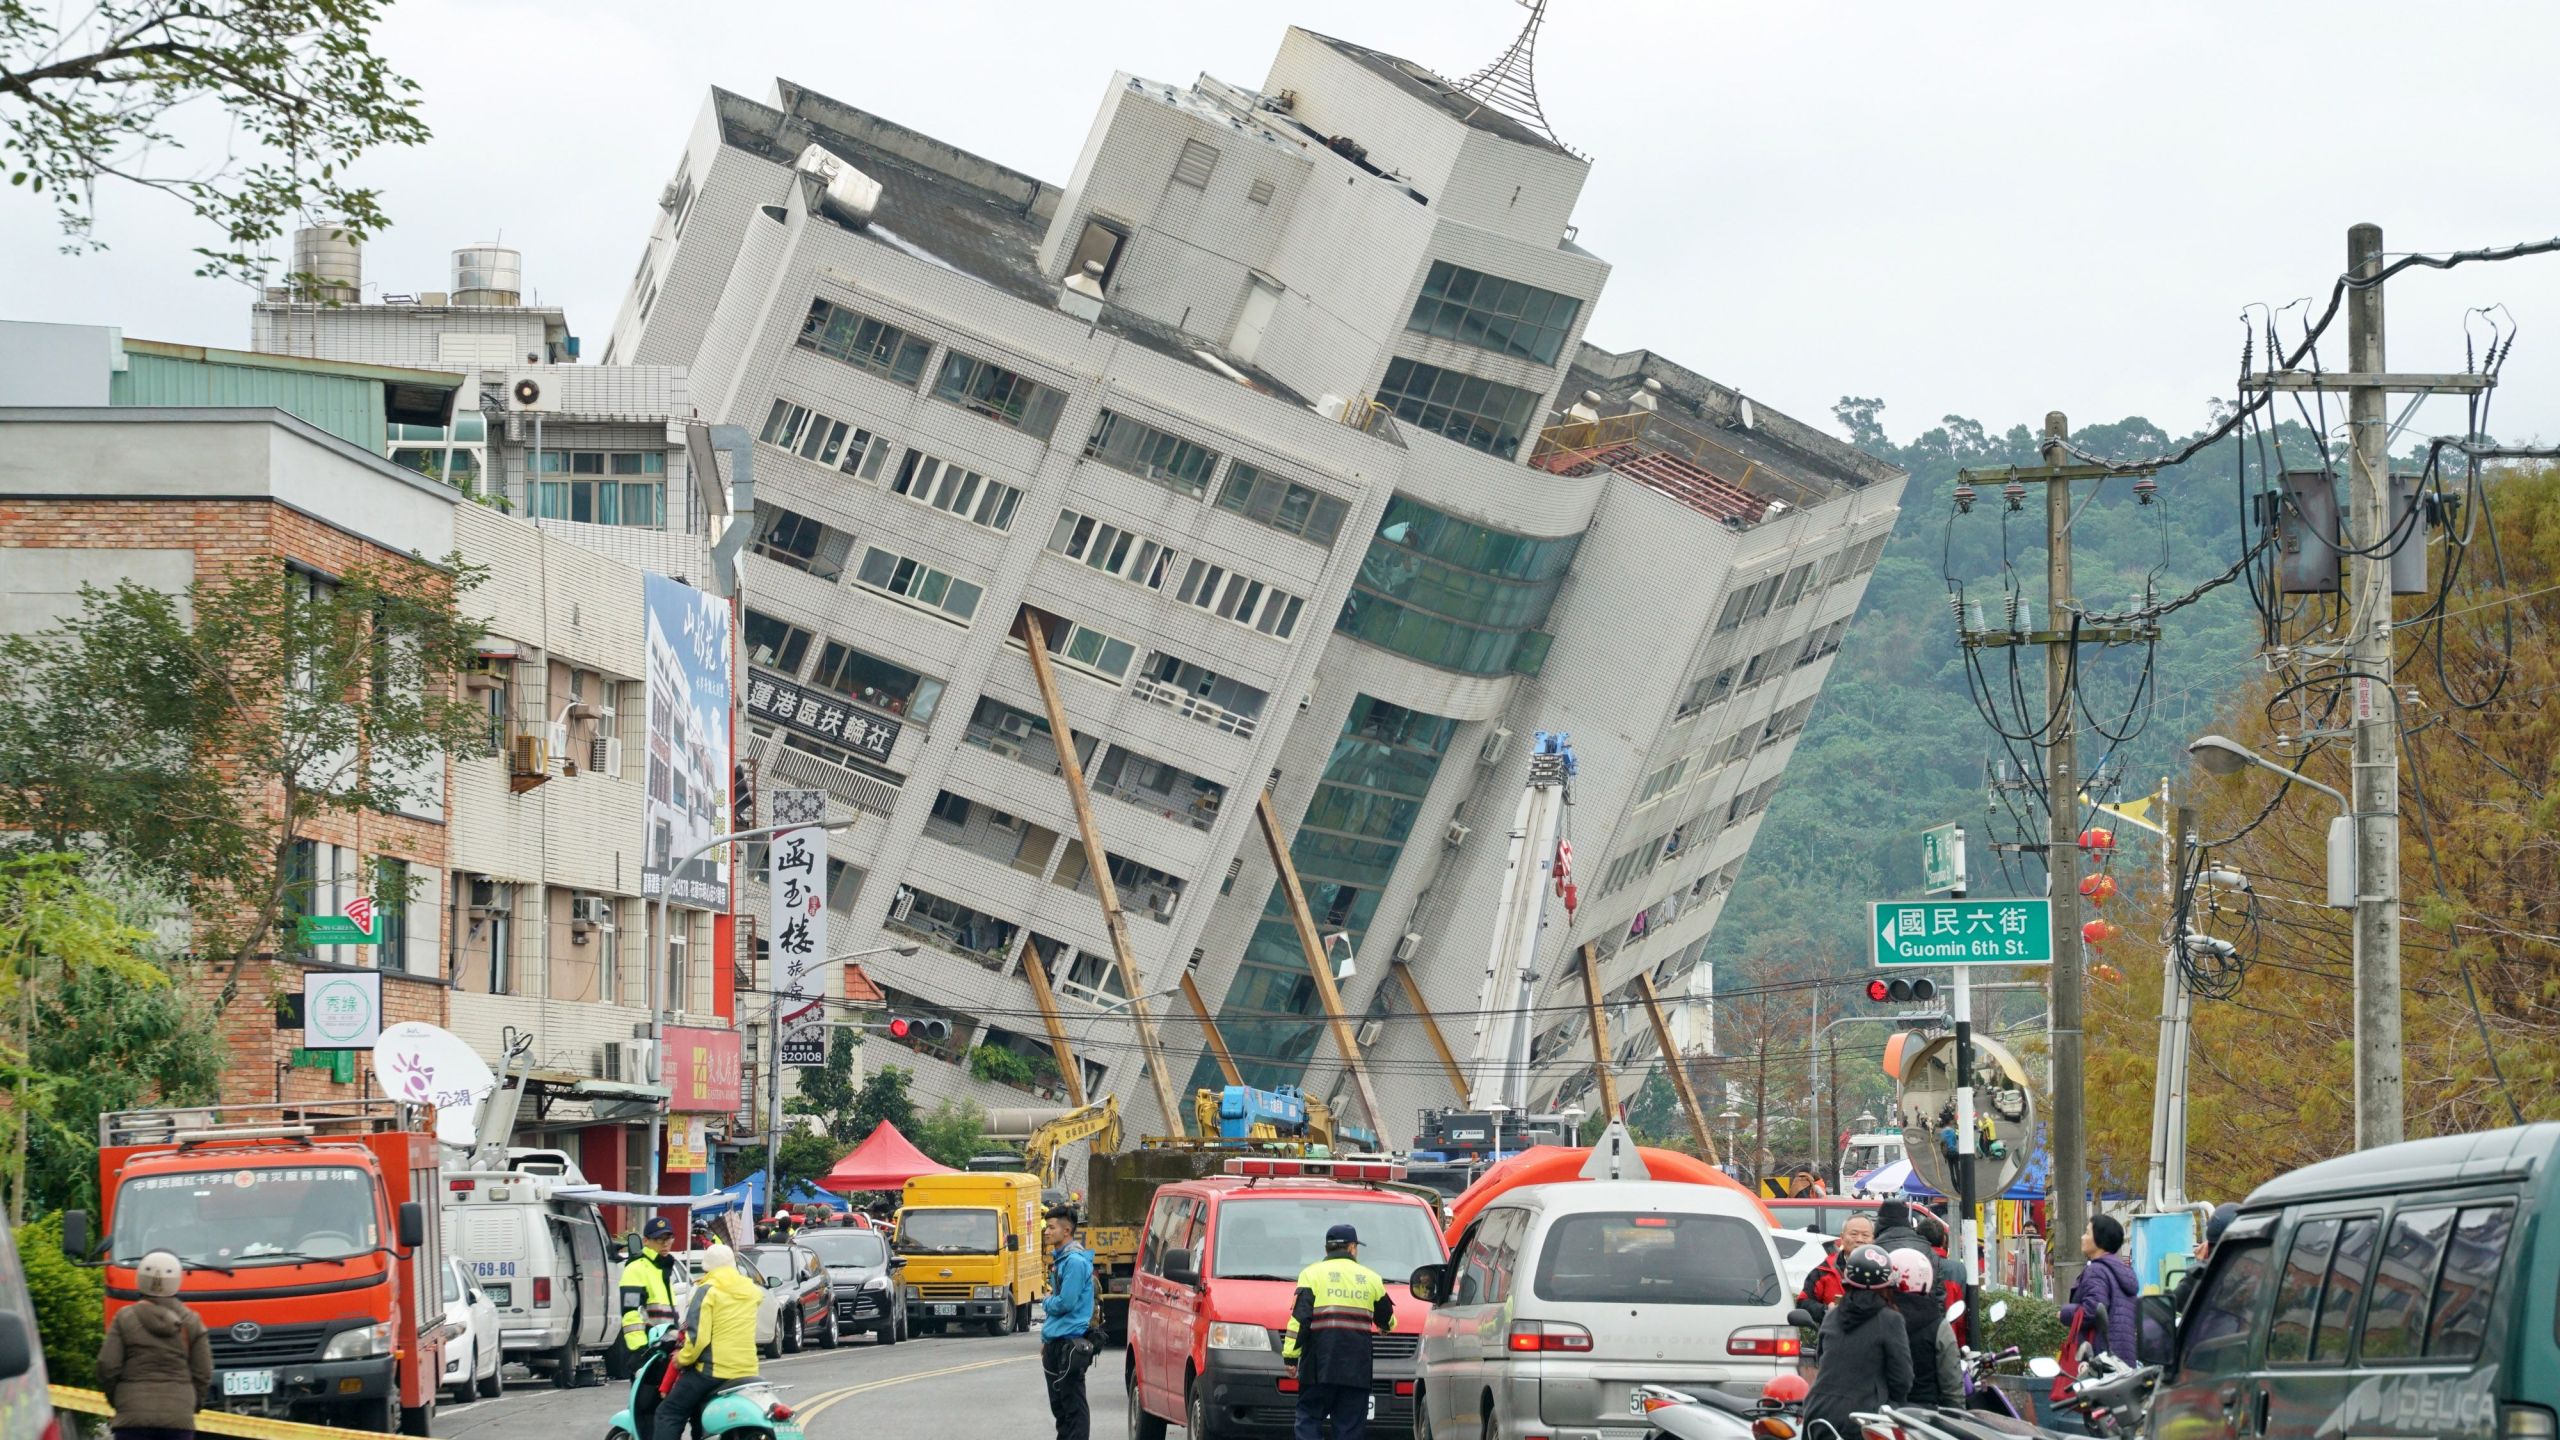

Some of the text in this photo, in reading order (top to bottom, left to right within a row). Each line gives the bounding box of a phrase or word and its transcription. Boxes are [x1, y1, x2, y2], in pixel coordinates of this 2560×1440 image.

[748, 680, 890, 753] 蓮港區扶輪社
[1898, 908, 2027, 937] 國民六街
[1900, 939, 2029, 957] Guomin 6th St.
[437, 1089, 472, 1107] 公視
[1327, 1288, 1370, 1300] POLICE
[2401, 1387, 2497, 1429] DELICA
